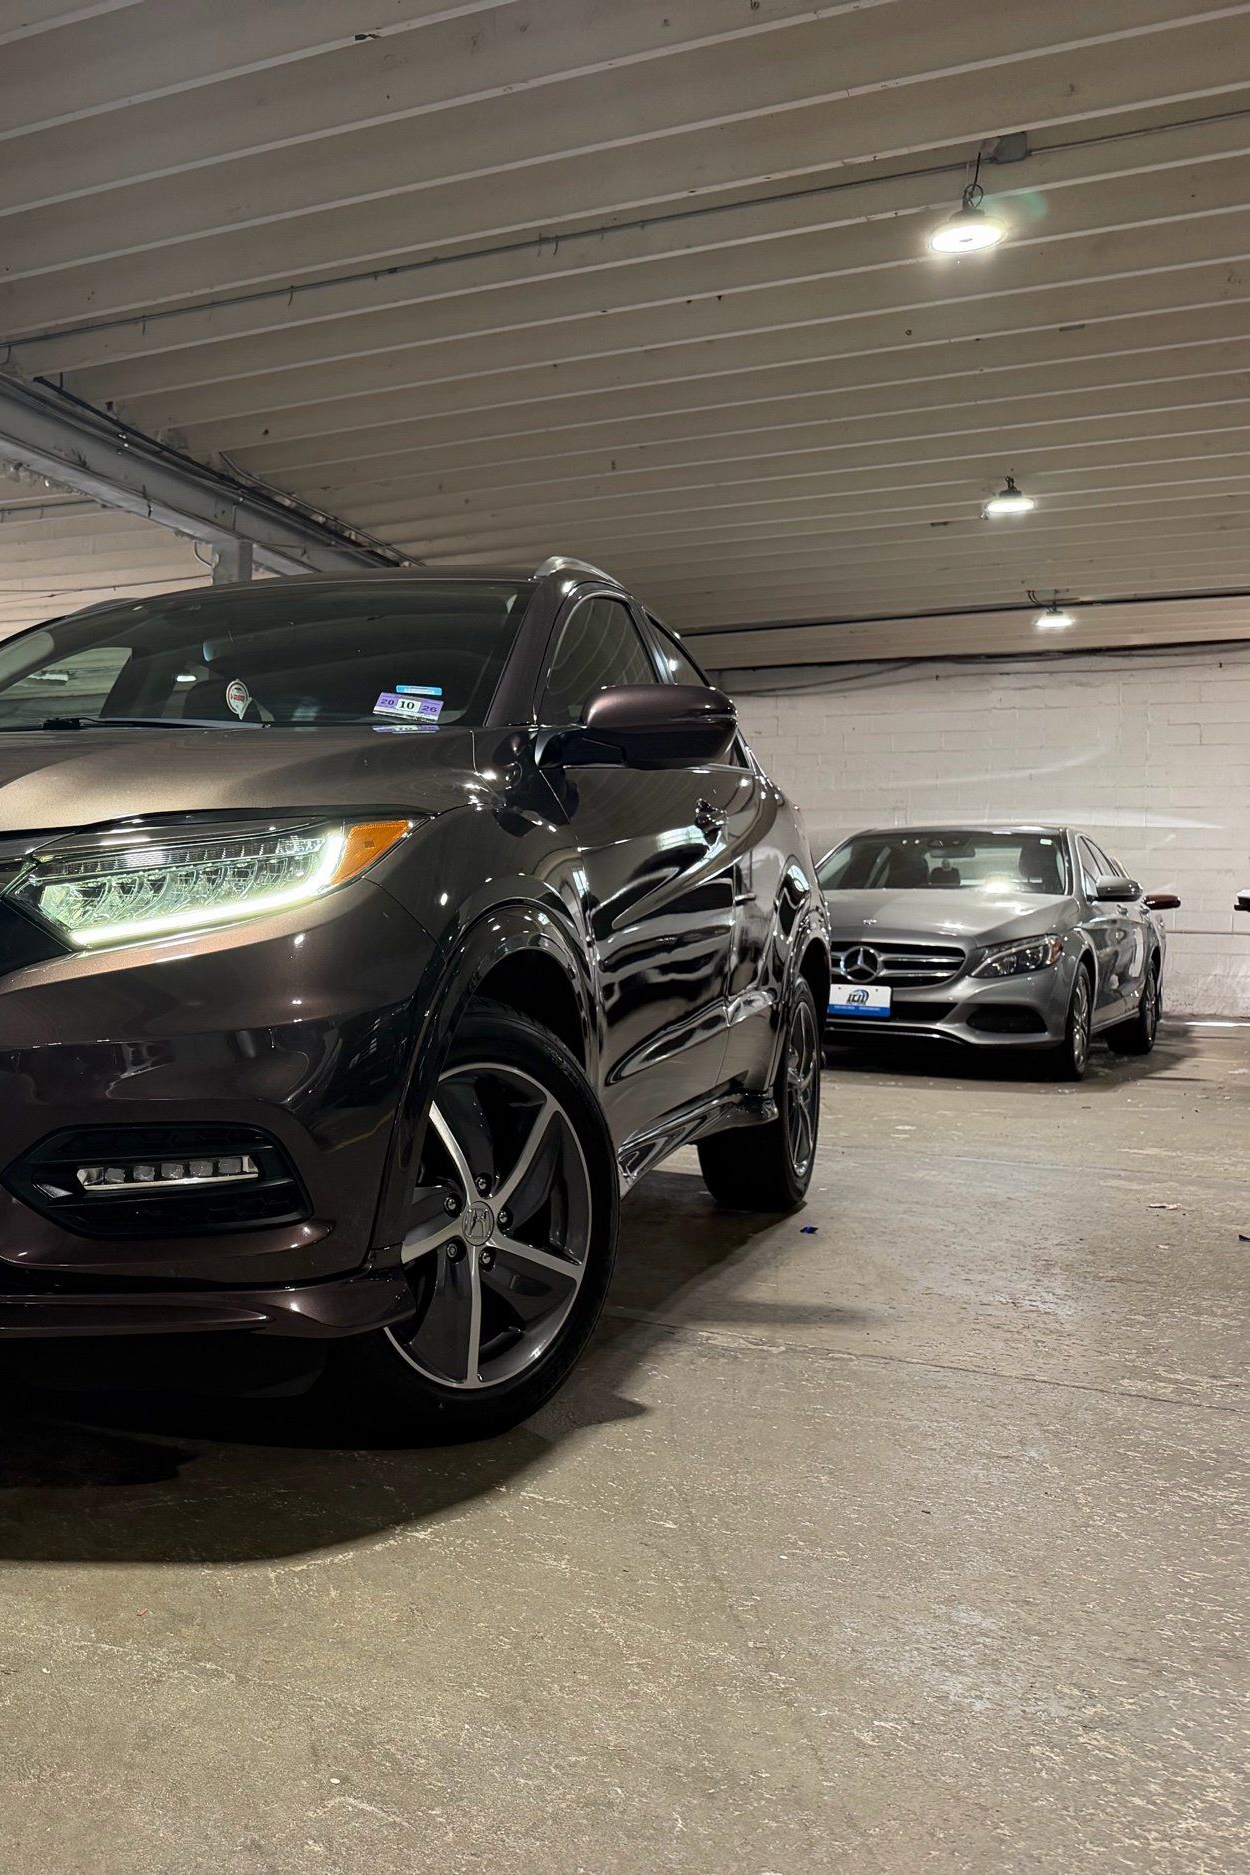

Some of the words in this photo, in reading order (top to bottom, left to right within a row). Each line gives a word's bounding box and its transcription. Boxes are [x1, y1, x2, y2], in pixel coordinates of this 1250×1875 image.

[380, 698, 395, 706] 20
[399, 700, 415, 710] 10
[422, 705, 437, 713] 26
